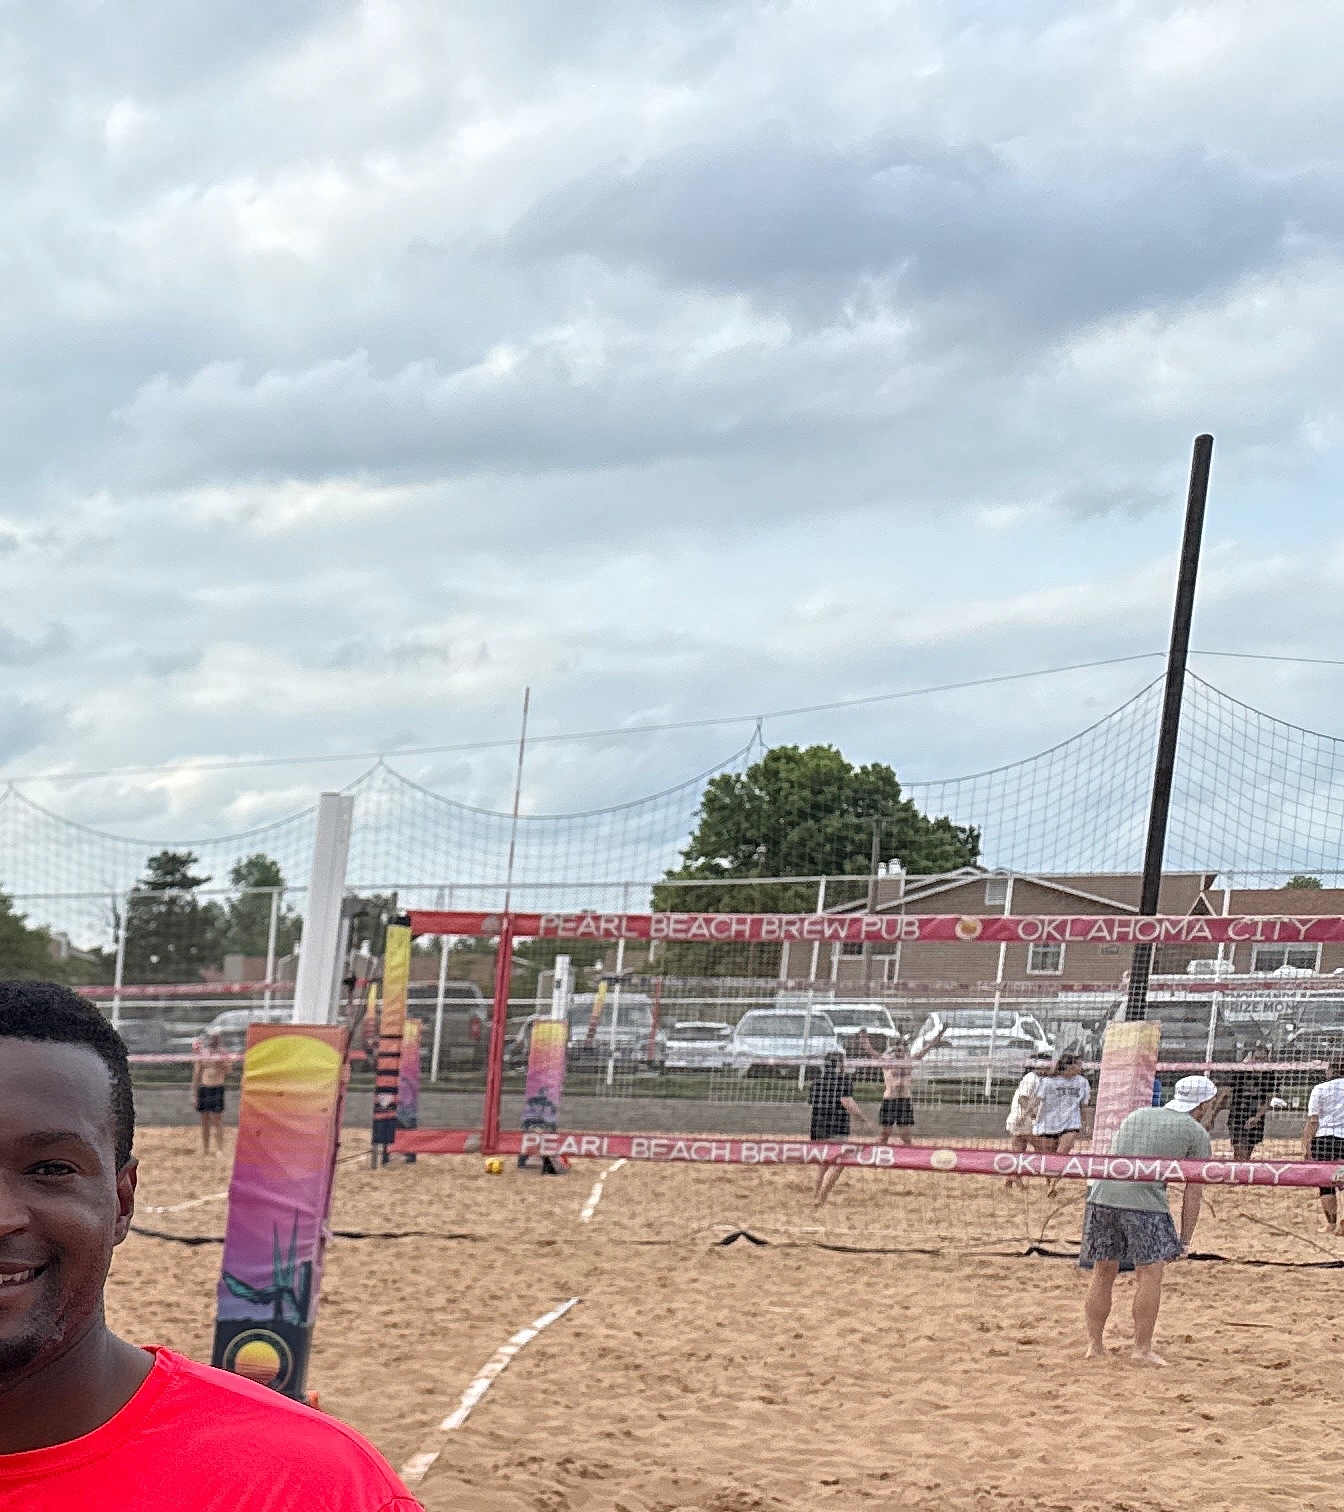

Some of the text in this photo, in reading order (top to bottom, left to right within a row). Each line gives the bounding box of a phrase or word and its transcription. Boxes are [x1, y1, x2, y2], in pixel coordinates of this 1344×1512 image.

[538, 915, 921, 940] PEARL BEACH BREW PUB
[1017, 918, 1319, 941] OKLAHOMA CITY
[520, 1133, 610, 1156] PEARL
[631, 1137, 730, 1161] BEACH
[741, 1140, 829, 1164] BREW
[993, 1153, 1293, 1185] OKLAHOMA CITY
